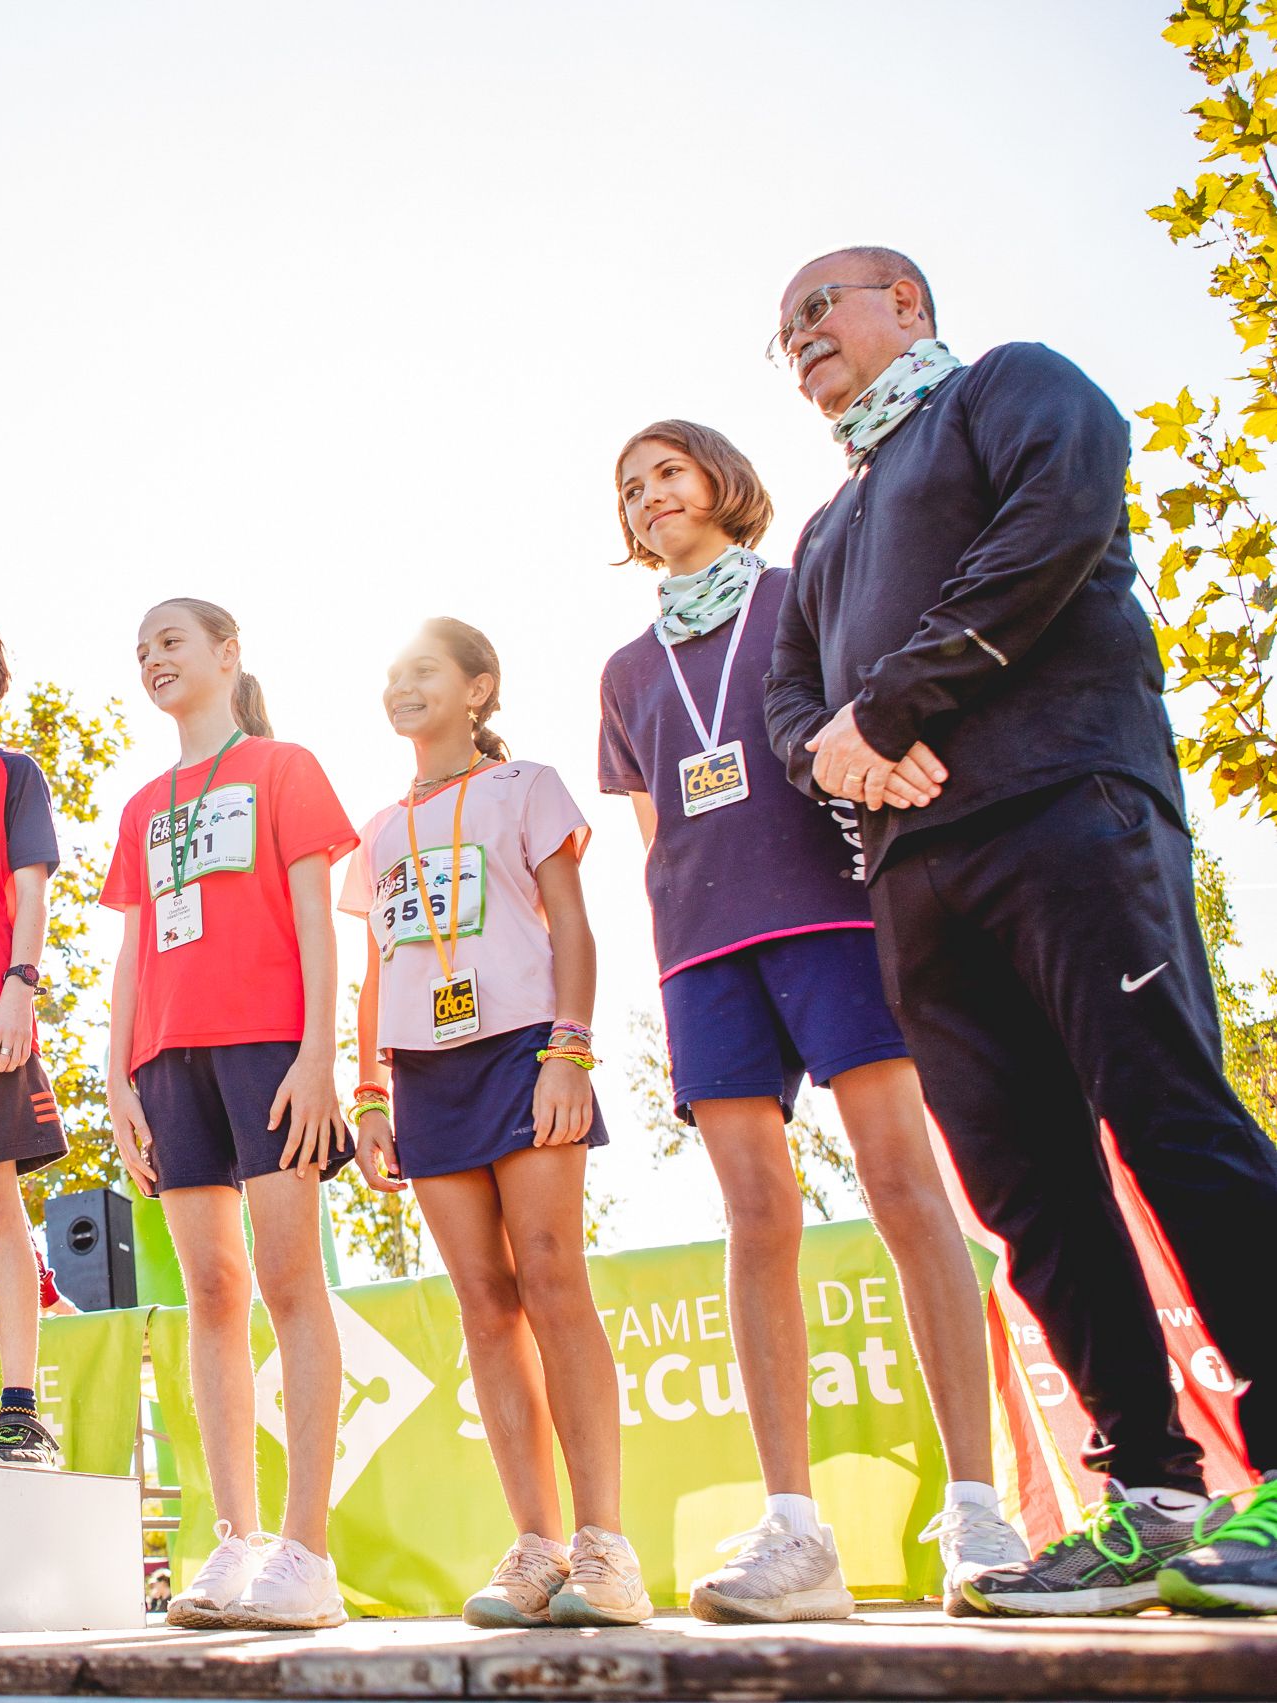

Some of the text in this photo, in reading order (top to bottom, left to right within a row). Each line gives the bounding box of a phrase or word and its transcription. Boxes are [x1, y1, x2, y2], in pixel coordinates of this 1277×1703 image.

[688, 764, 740, 795] CROS
[383, 894, 446, 930] 356
[435, 993, 474, 1020] CROS
[817, 1277, 892, 1328] DE
[456, 1336, 904, 1441] stCuat
